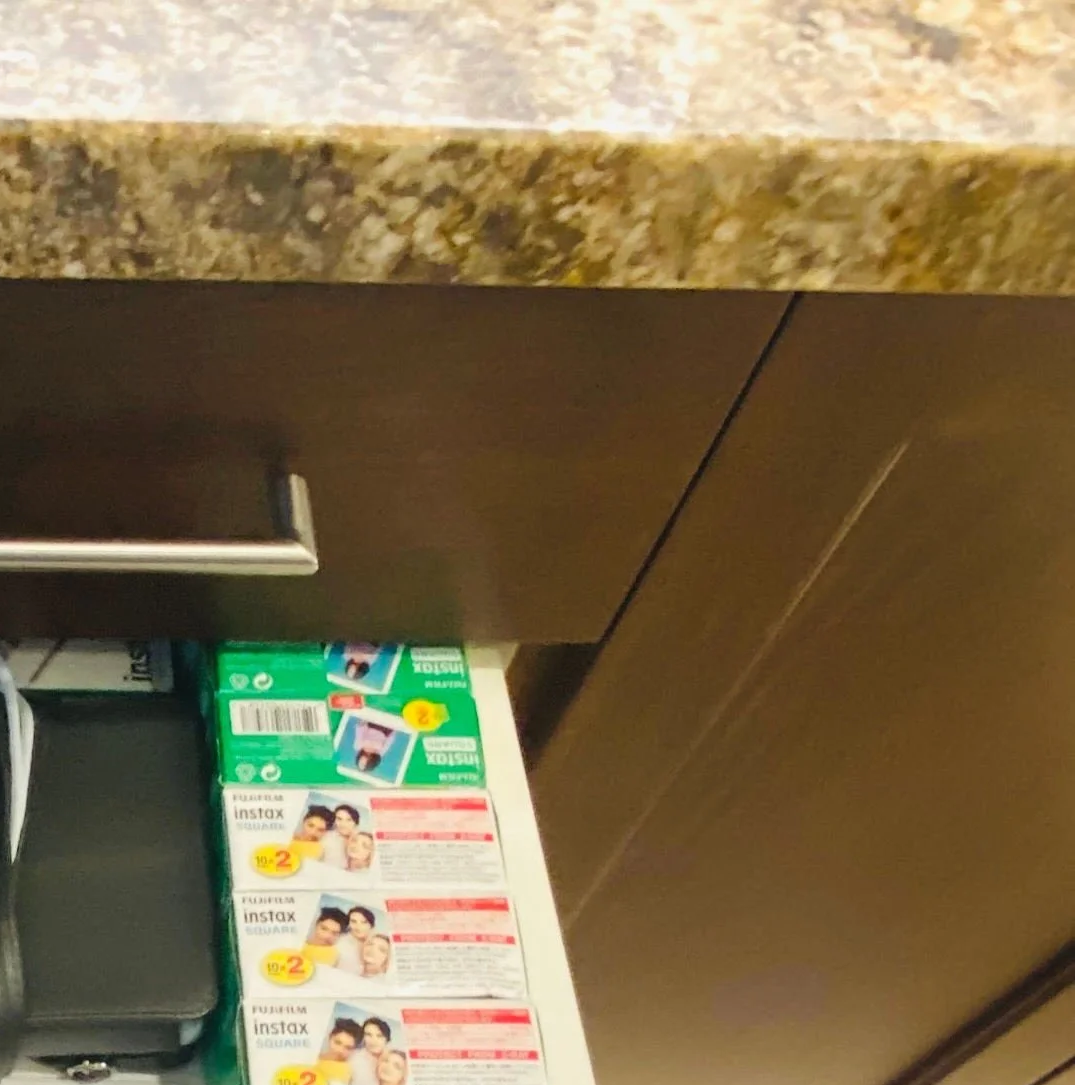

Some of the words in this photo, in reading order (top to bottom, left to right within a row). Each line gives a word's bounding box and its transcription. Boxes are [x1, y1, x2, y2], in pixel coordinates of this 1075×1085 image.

[425, 752, 480, 771] instax
[234, 806, 285, 820] instax
[244, 908, 296, 923] instax
[254, 1018, 309, 1035] instax
